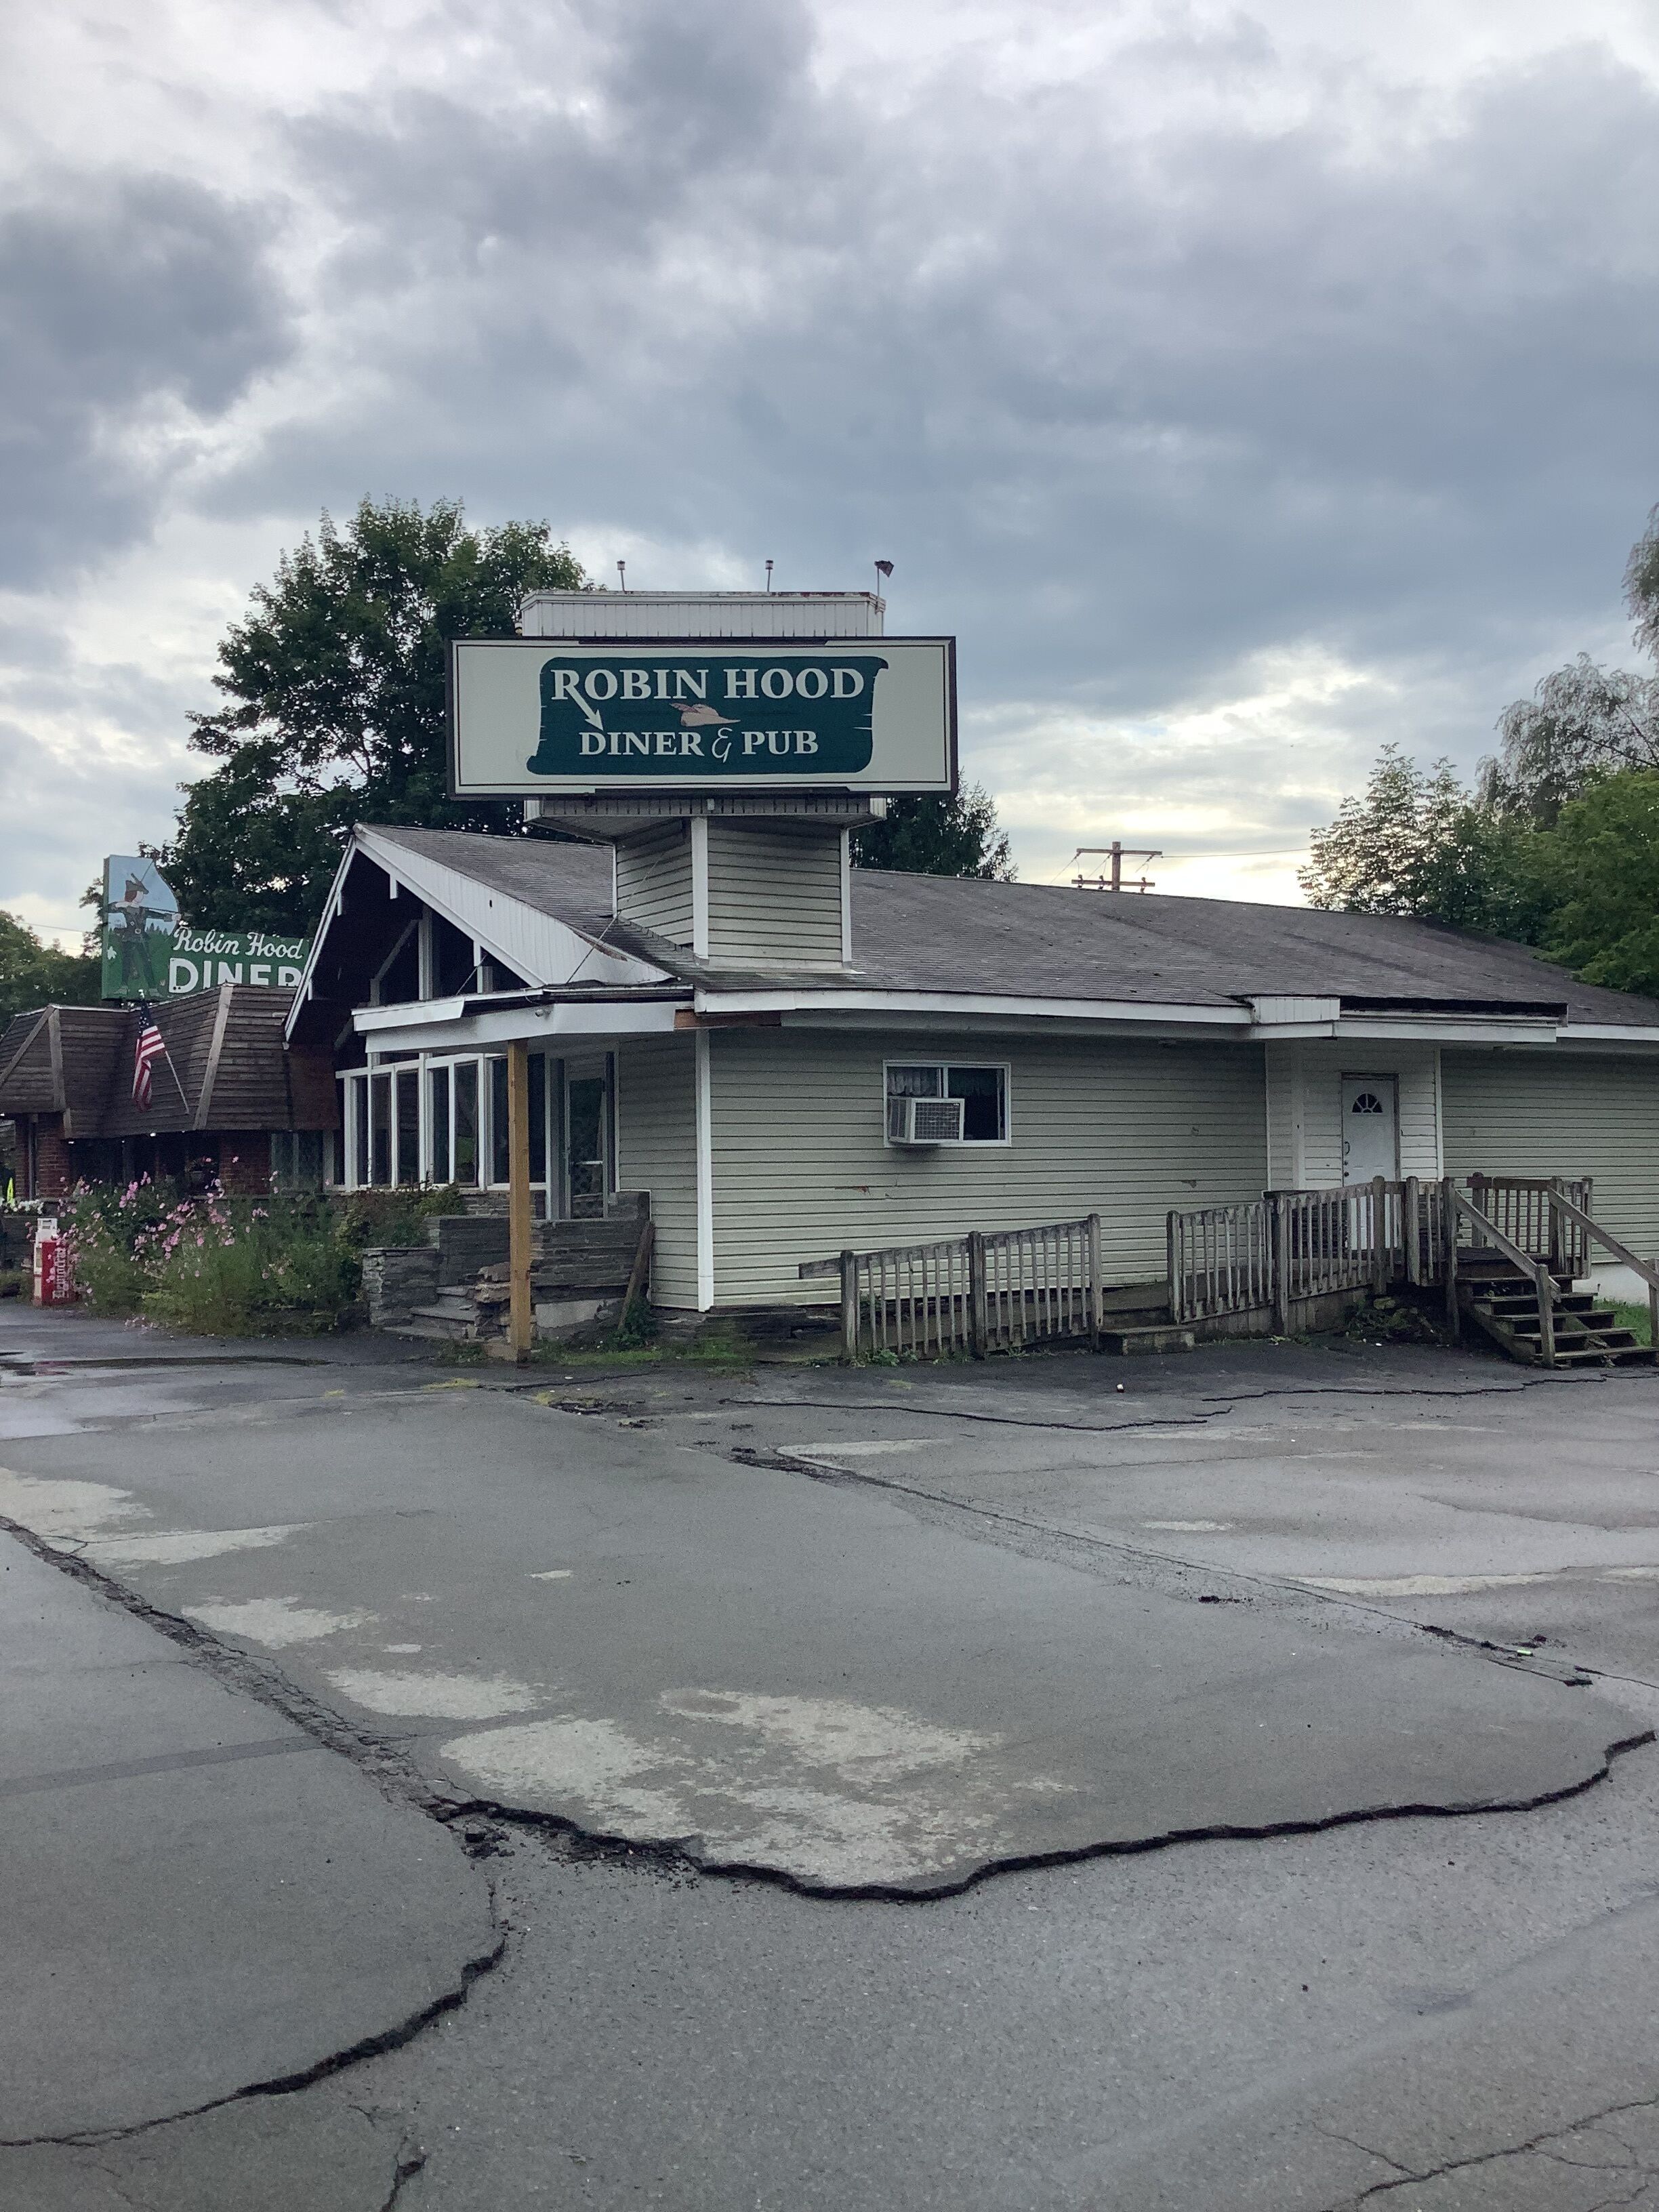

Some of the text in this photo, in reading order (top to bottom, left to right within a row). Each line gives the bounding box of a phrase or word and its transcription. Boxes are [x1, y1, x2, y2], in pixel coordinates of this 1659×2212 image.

[551, 668, 865, 712] ROBIN HOOD
[579, 727, 819, 763] DINER & PUB
[173, 926, 304, 960] Robin Hood
